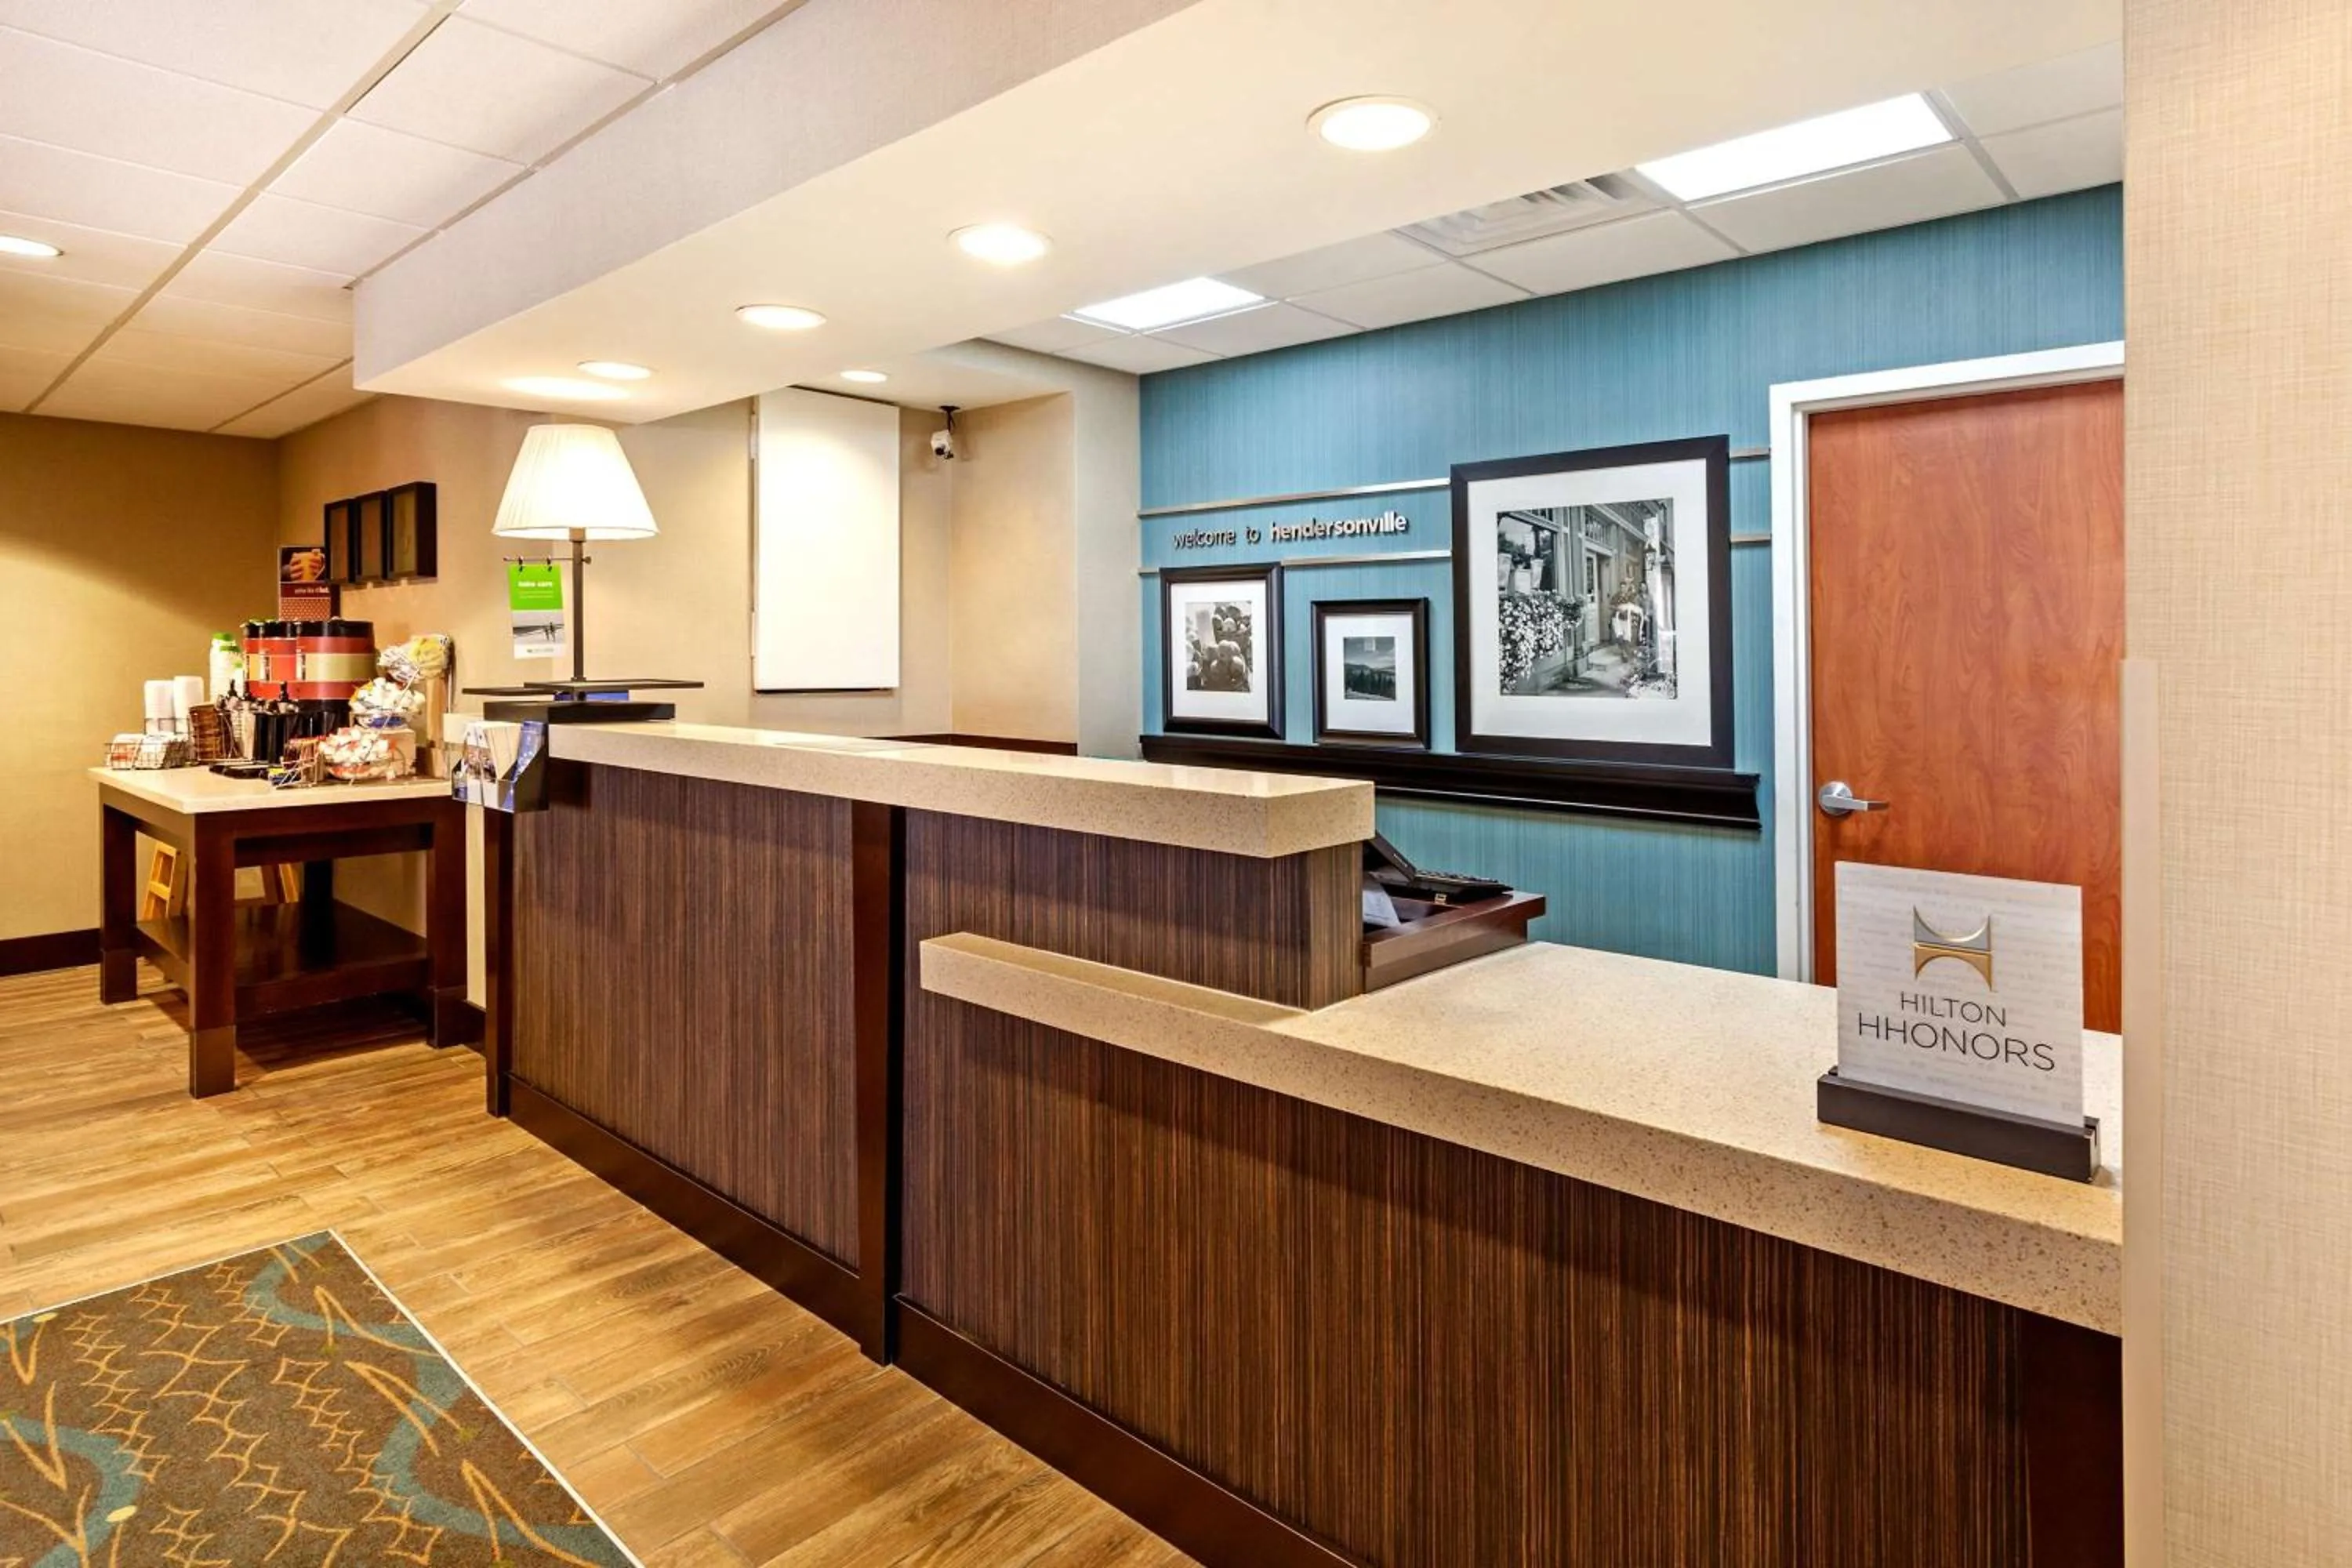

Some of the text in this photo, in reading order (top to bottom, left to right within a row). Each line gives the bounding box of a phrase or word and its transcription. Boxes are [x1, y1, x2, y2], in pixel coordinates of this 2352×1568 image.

[1173, 511, 1409, 548] welcome to hendersonville
[1901, 993, 2006, 1027] HILTON
[1859, 1012, 2055, 1071] HHONORS
